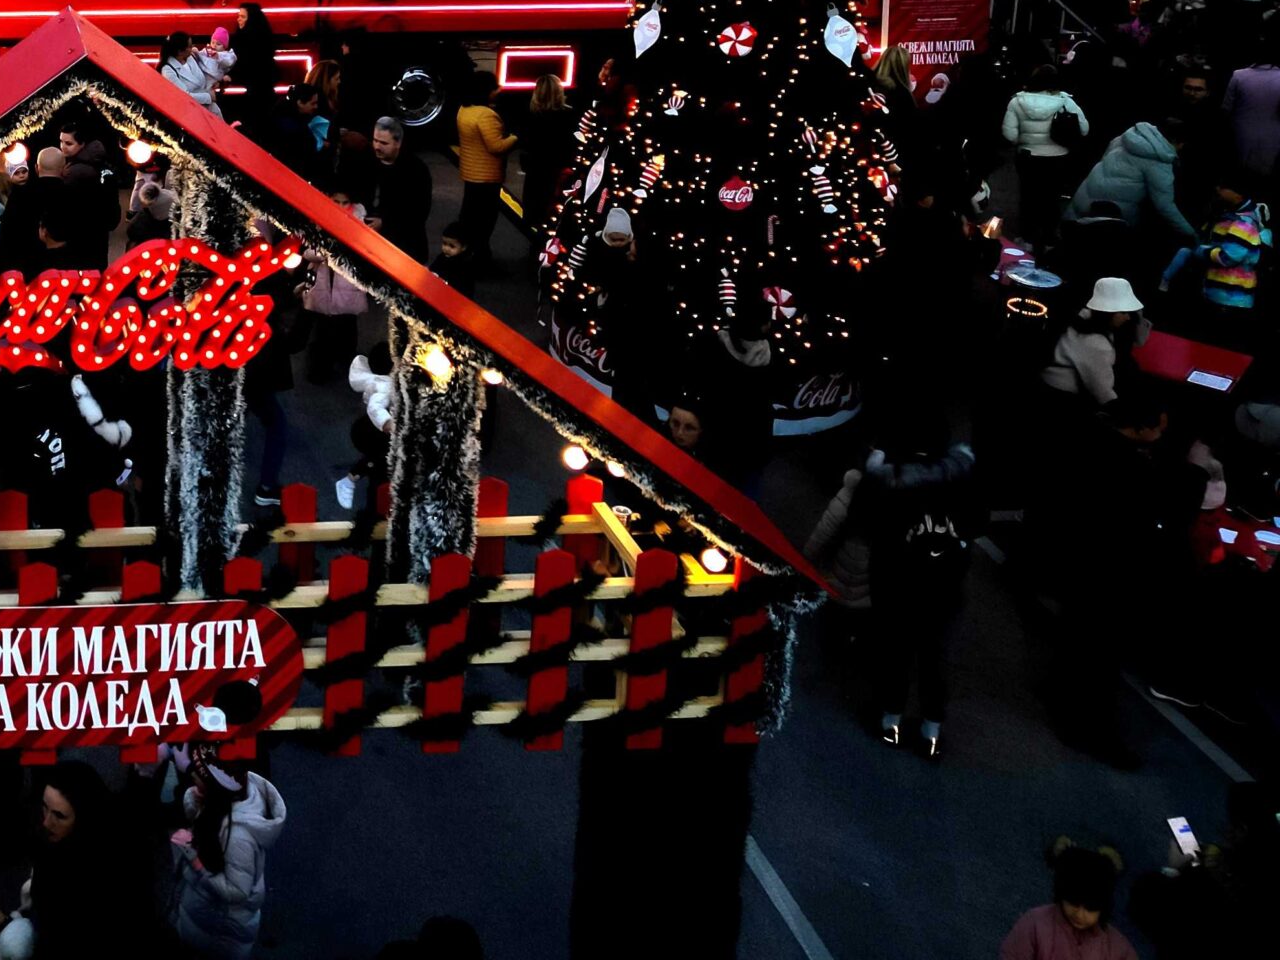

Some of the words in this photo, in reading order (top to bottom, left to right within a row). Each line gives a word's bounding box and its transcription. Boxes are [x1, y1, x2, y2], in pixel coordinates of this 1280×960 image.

[912, 53, 924, 65] НА
[926, 52, 959, 65] КОЛЕДА
[936, 40, 975, 52] МАГИЯТА
[72, 619, 267, 676] МАГИЯТА
[26, 678, 190, 737] КОЛЕДА
